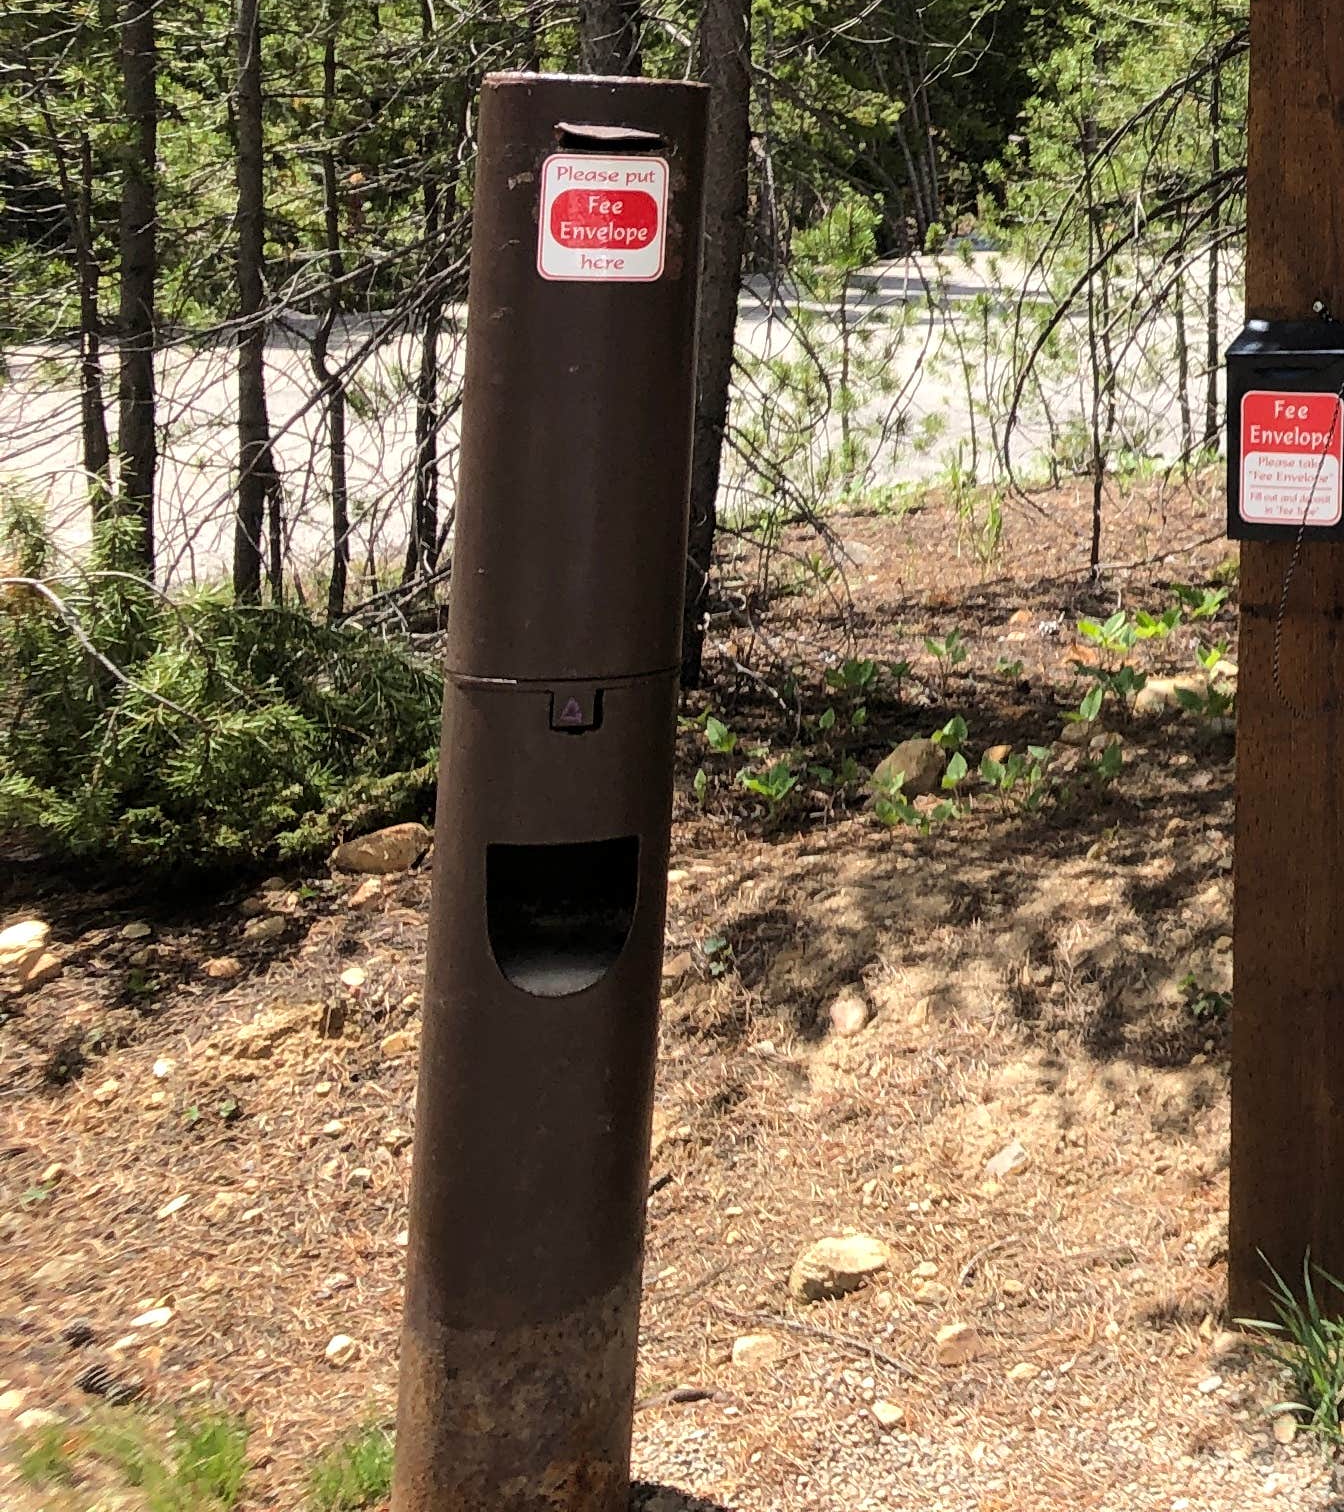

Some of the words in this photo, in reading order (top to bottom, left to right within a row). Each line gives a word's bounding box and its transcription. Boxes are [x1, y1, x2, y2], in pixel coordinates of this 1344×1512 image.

[557, 165, 619, 182] Please
[625, 170, 655, 186] put
[588, 195, 622, 215] Fee
[559, 221, 649, 245] Envelope
[581, 253, 624, 270] here
[1274, 399, 1308, 419] Fee
[1258, 456, 1295, 468] Please
